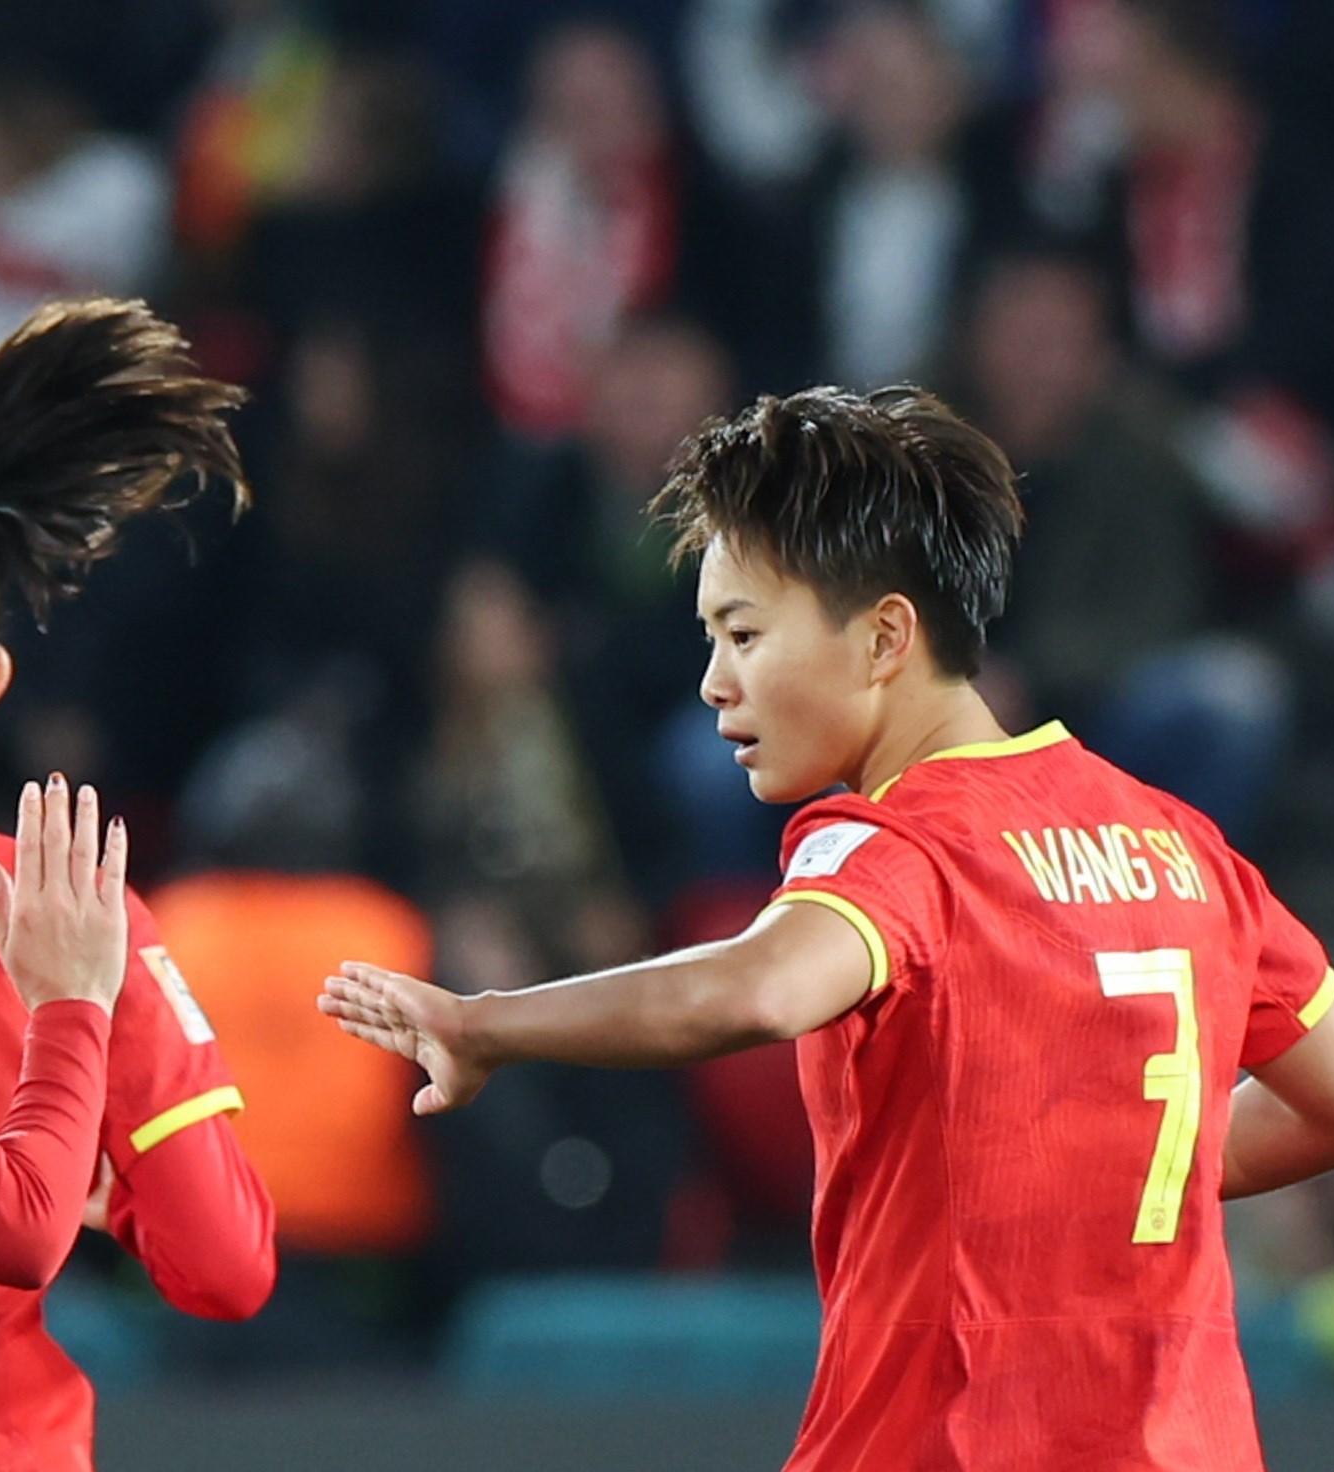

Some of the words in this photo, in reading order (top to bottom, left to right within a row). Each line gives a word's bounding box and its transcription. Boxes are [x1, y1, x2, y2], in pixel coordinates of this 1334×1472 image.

[1001, 823, 1157, 904] WANG
[1141, 827, 1209, 903] SH
[1094, 947, 1202, 1244] 7
